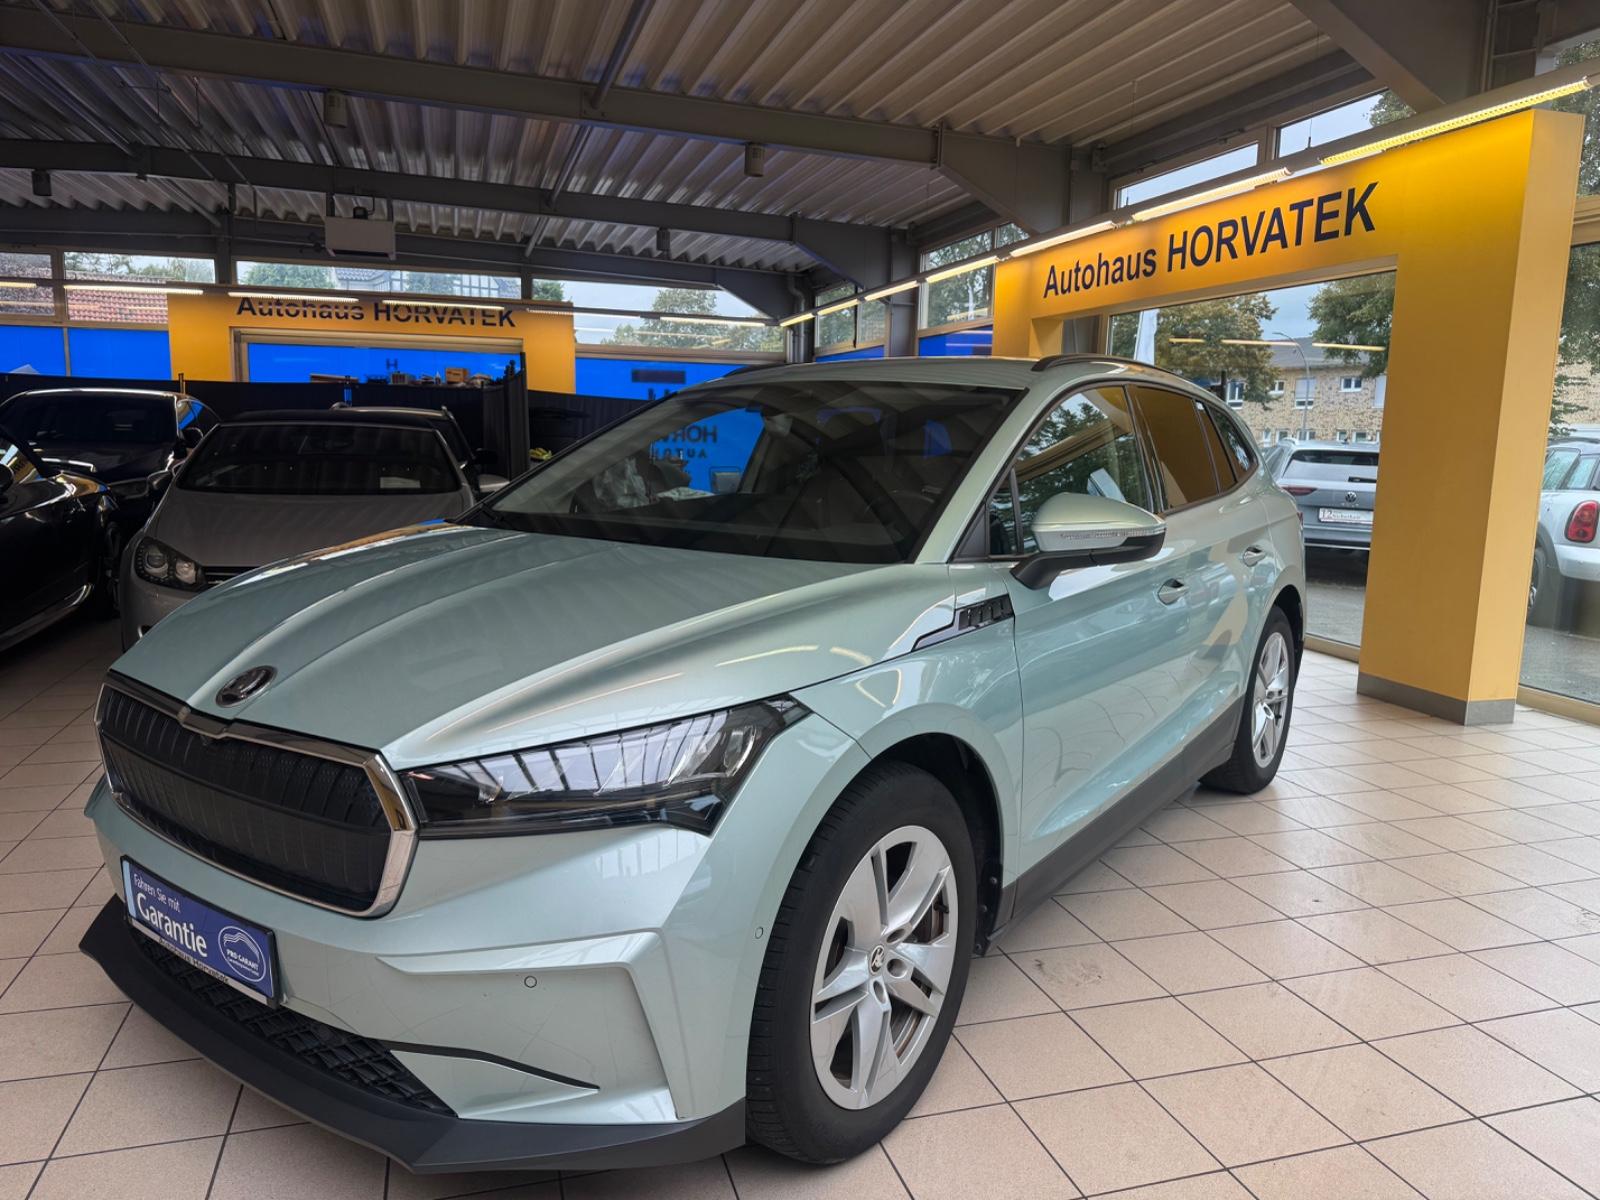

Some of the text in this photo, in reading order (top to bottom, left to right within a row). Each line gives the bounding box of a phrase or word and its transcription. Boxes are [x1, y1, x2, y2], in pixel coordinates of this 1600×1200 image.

[1043, 181, 1379, 299] Autohaus HORVATEK
[236, 297, 516, 328] Autohaus HORVATEK
[133, 873, 181, 913] Fahren Sie mit
[136, 892, 208, 958] Garantie
